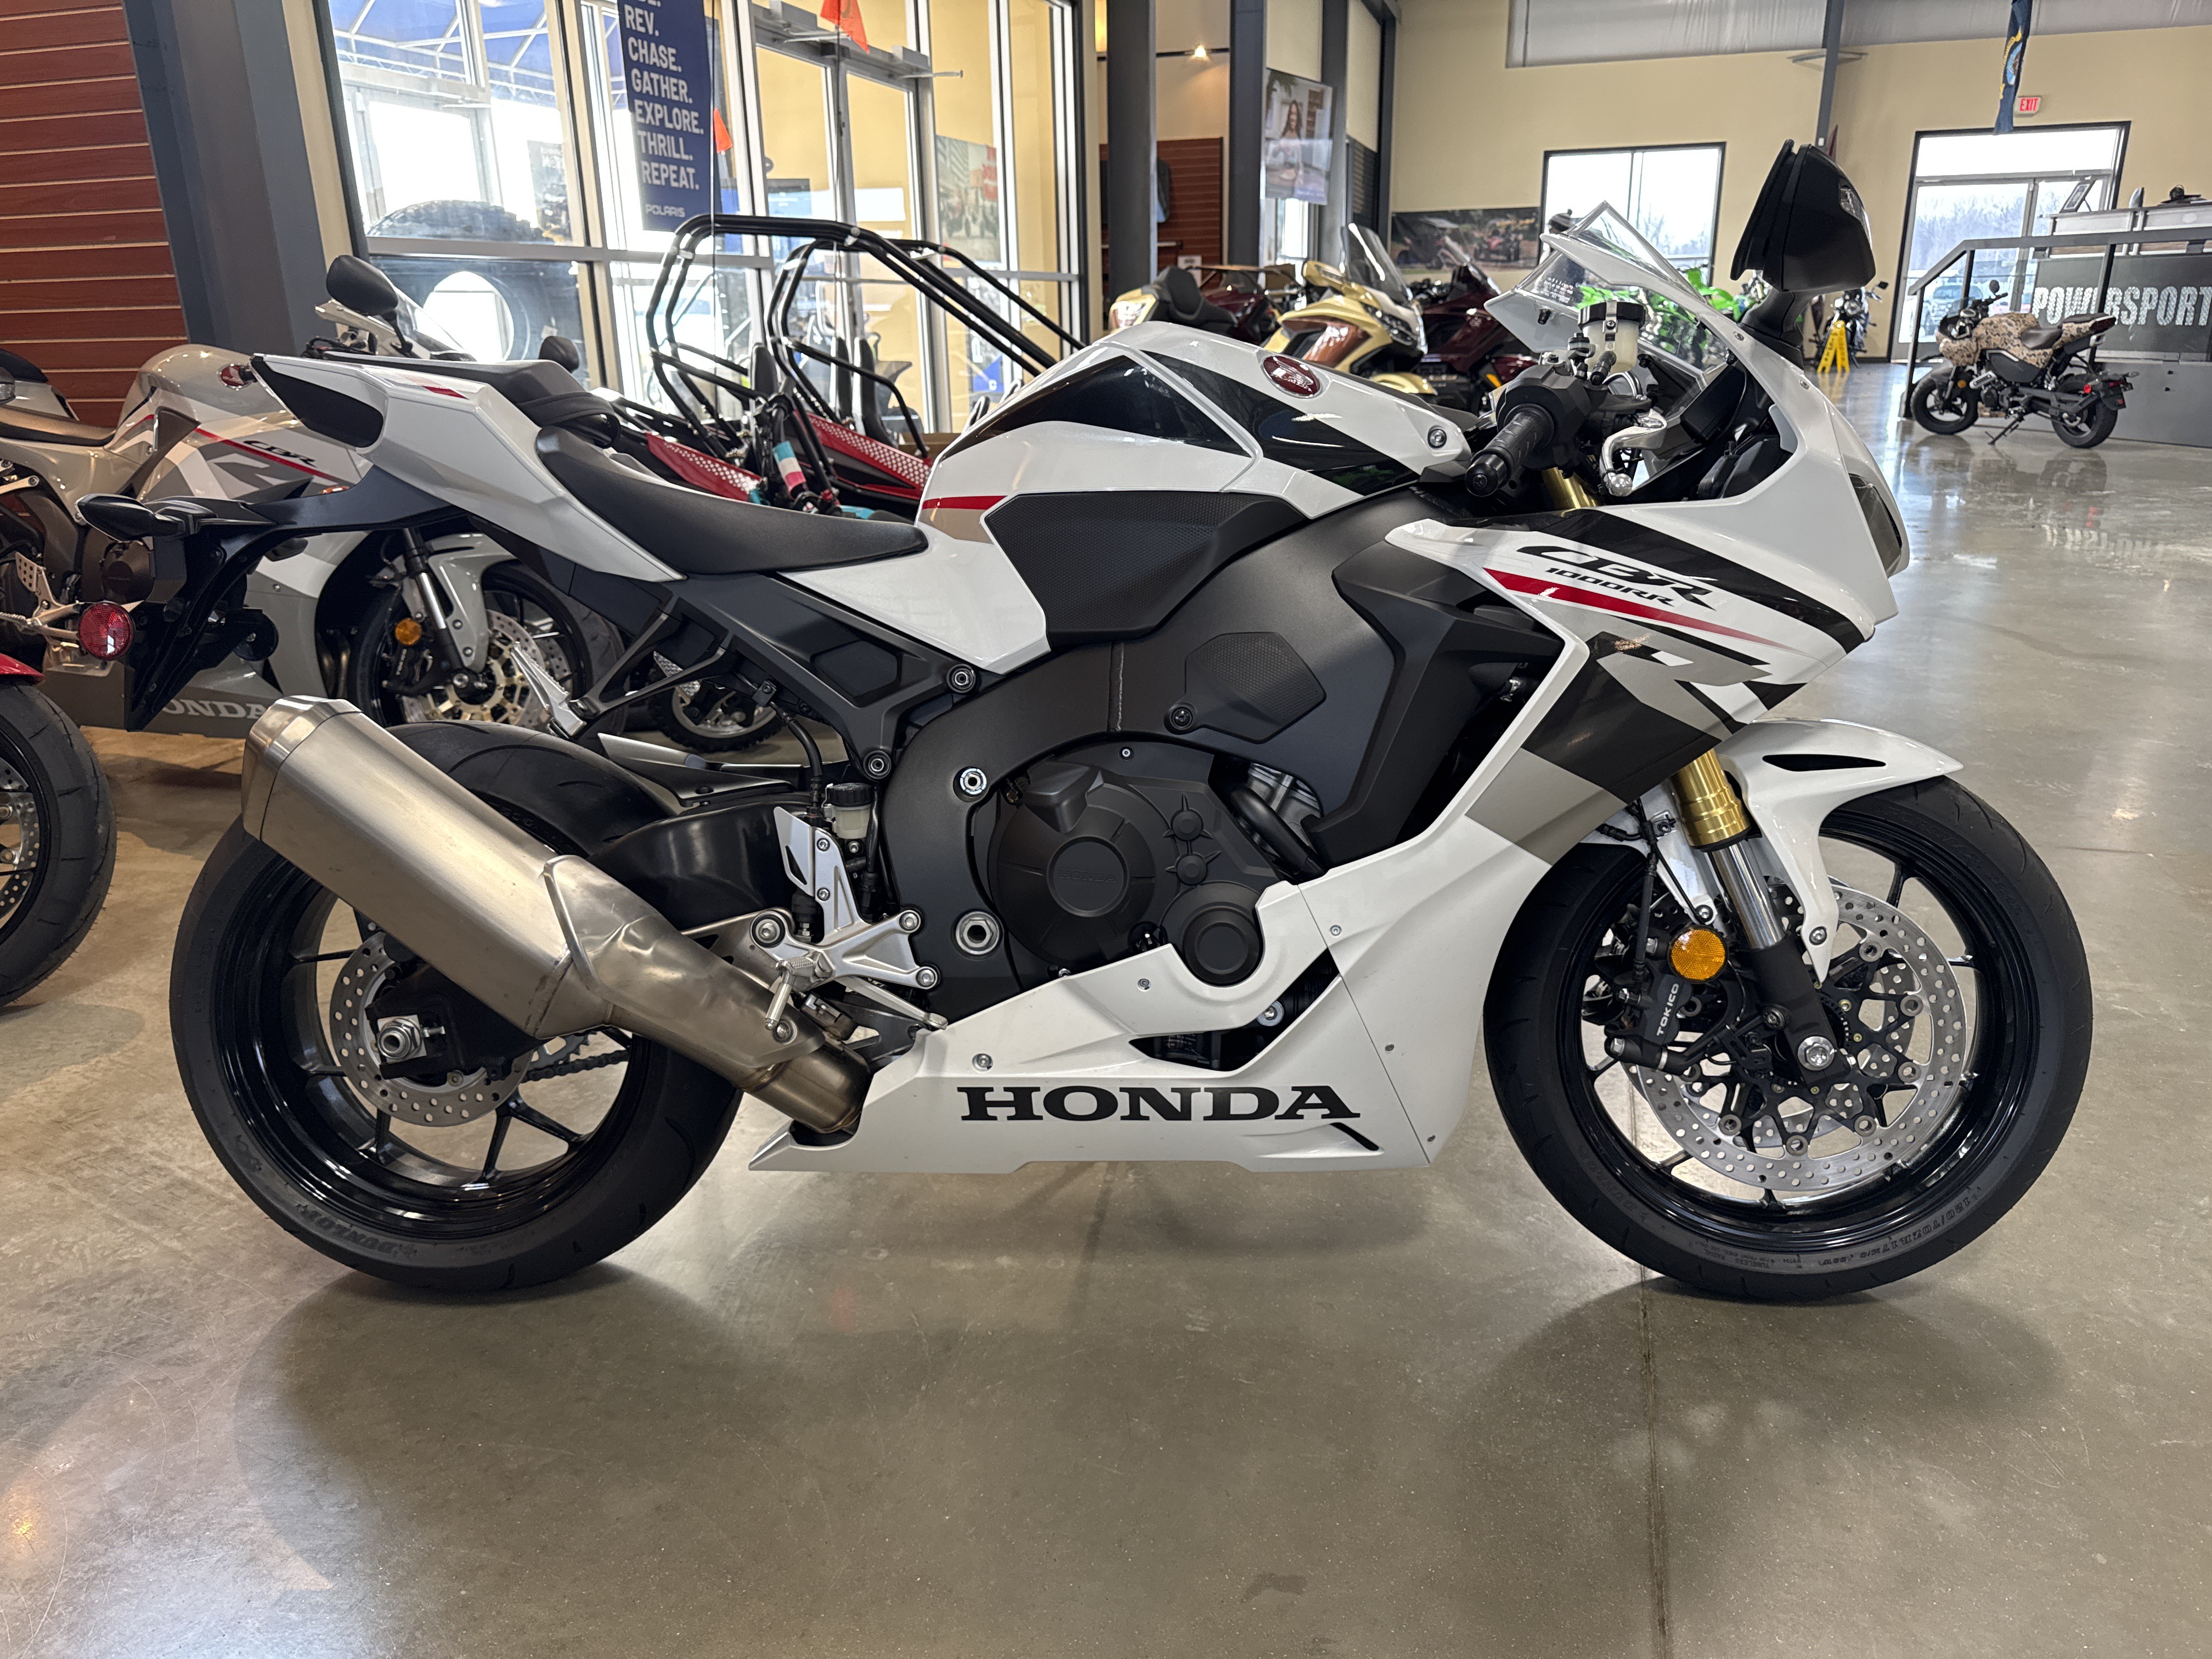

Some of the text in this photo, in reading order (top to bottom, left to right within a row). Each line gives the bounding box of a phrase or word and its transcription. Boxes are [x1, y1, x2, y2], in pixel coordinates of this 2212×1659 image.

[624, 4, 659, 36] REV.
[628, 37, 682, 72] CHASE.
[631, 68, 693, 104] GATHER.
[634, 99, 704, 134] EXPLORE.
[2019, 98, 2039, 111] EXIT
[637, 131, 693, 161] THRILL.
[641, 161, 699, 190] REPEAT.
[645, 204, 685, 218] POLARIS
[2032, 286, 2212, 326] POWRSPORT
[1517, 545, 1717, 611] CBR
[1545, 567, 1675, 607] 1000RR
[163, 698, 267, 720] ONDA
[1058, 870, 1119, 883] HONDA
[1657, 983, 1679, 1036] TOKICO
[957, 1085, 1361, 1121] HONDA
